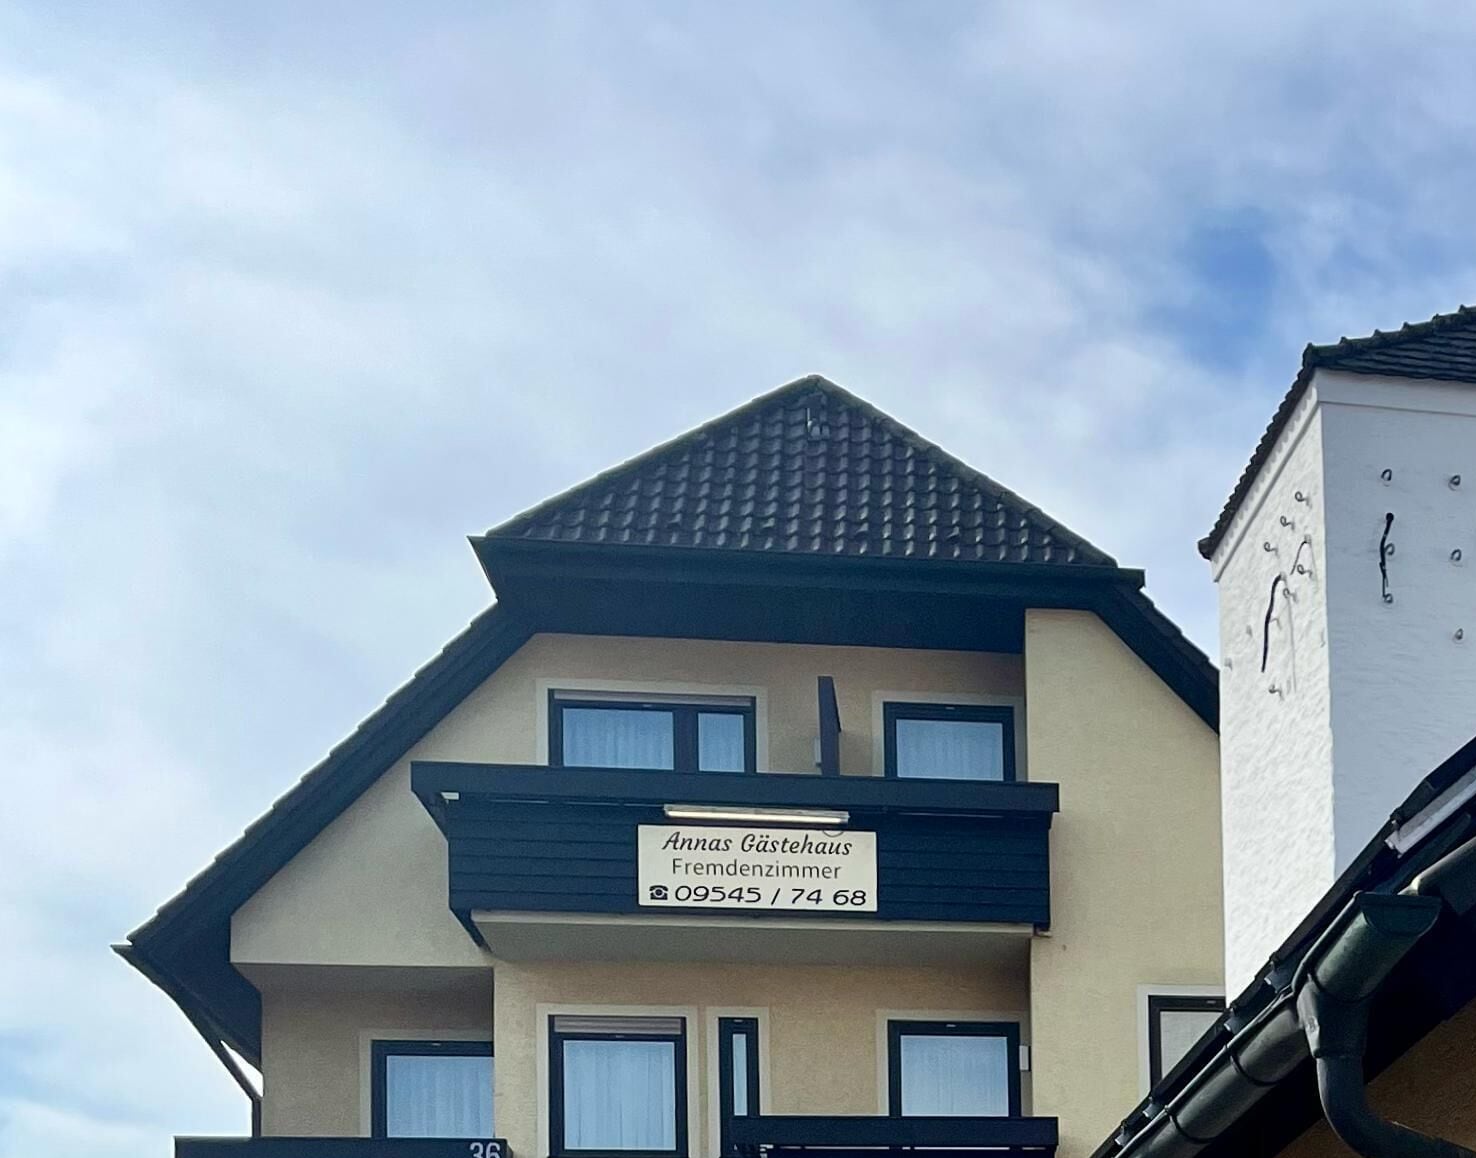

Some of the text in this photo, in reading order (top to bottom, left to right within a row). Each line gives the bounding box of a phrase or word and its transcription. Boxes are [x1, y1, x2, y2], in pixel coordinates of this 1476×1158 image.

[662, 831, 852, 856] Annas Gästehaus
[672, 858, 841, 880] Fremdenzimmer
[674, 885, 867, 906] 09545 / 74 68
